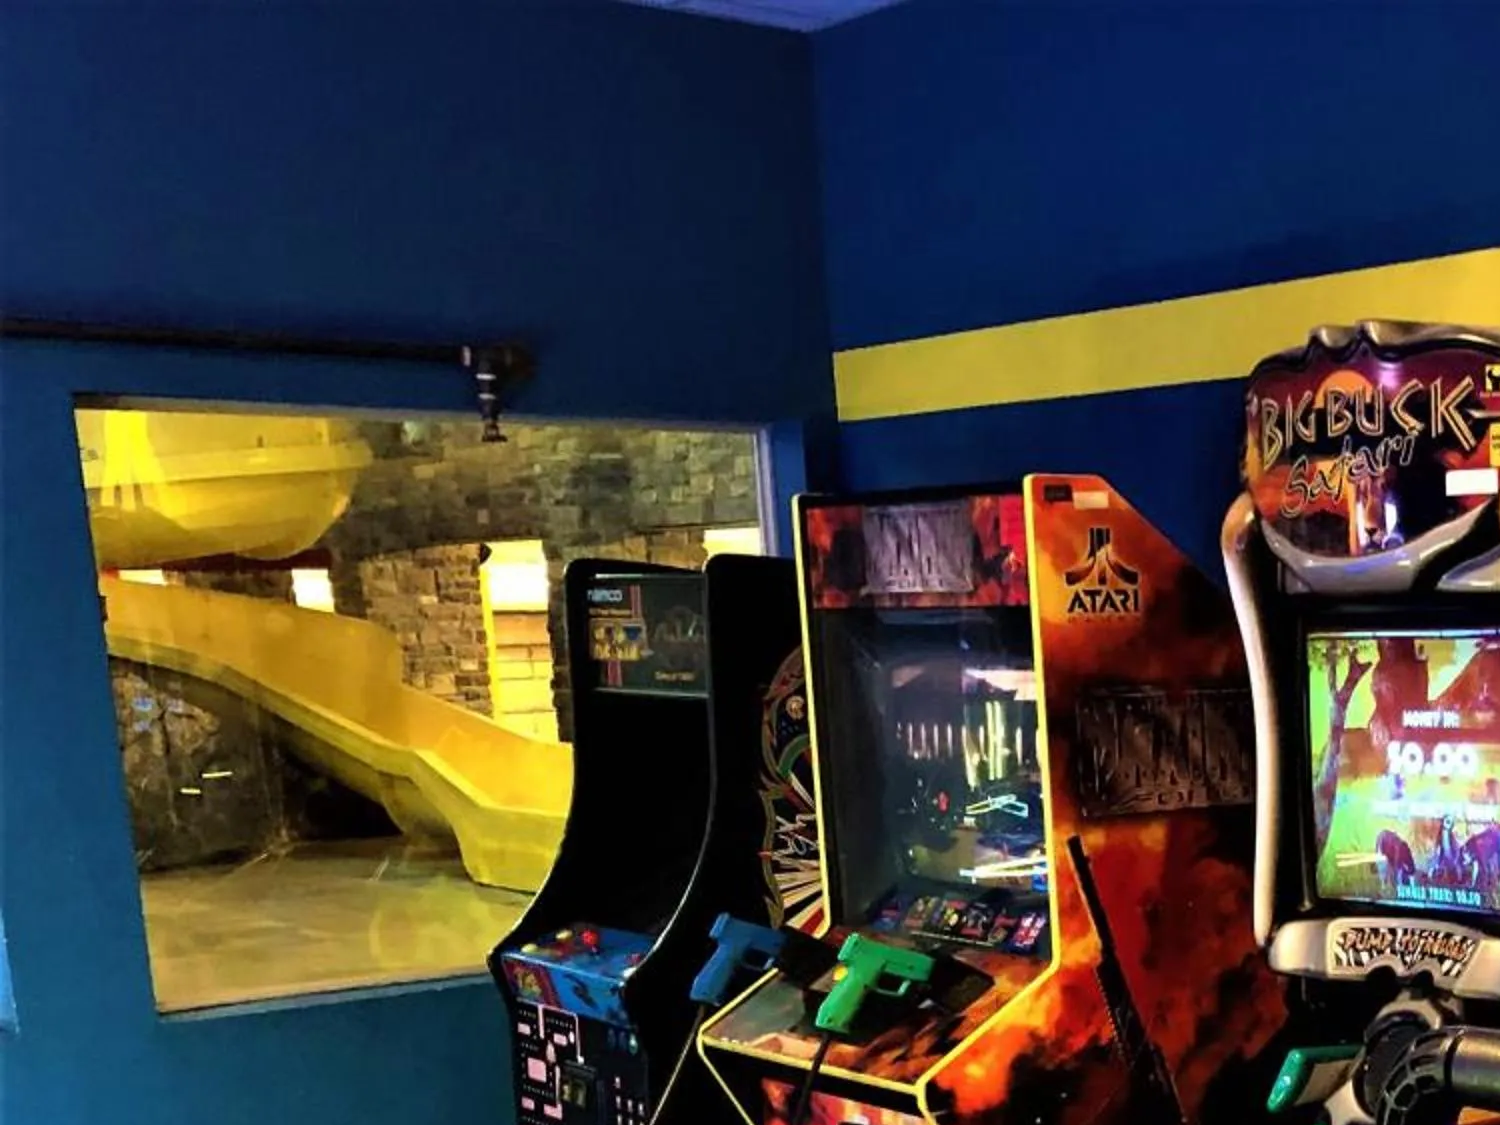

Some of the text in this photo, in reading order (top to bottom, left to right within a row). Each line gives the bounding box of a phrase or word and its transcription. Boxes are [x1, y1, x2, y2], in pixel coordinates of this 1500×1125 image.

[1260, 375, 1477, 473] BIG BUCK
[1281, 423, 1423, 518] Safari
[1067, 589, 1139, 613] ATARI
